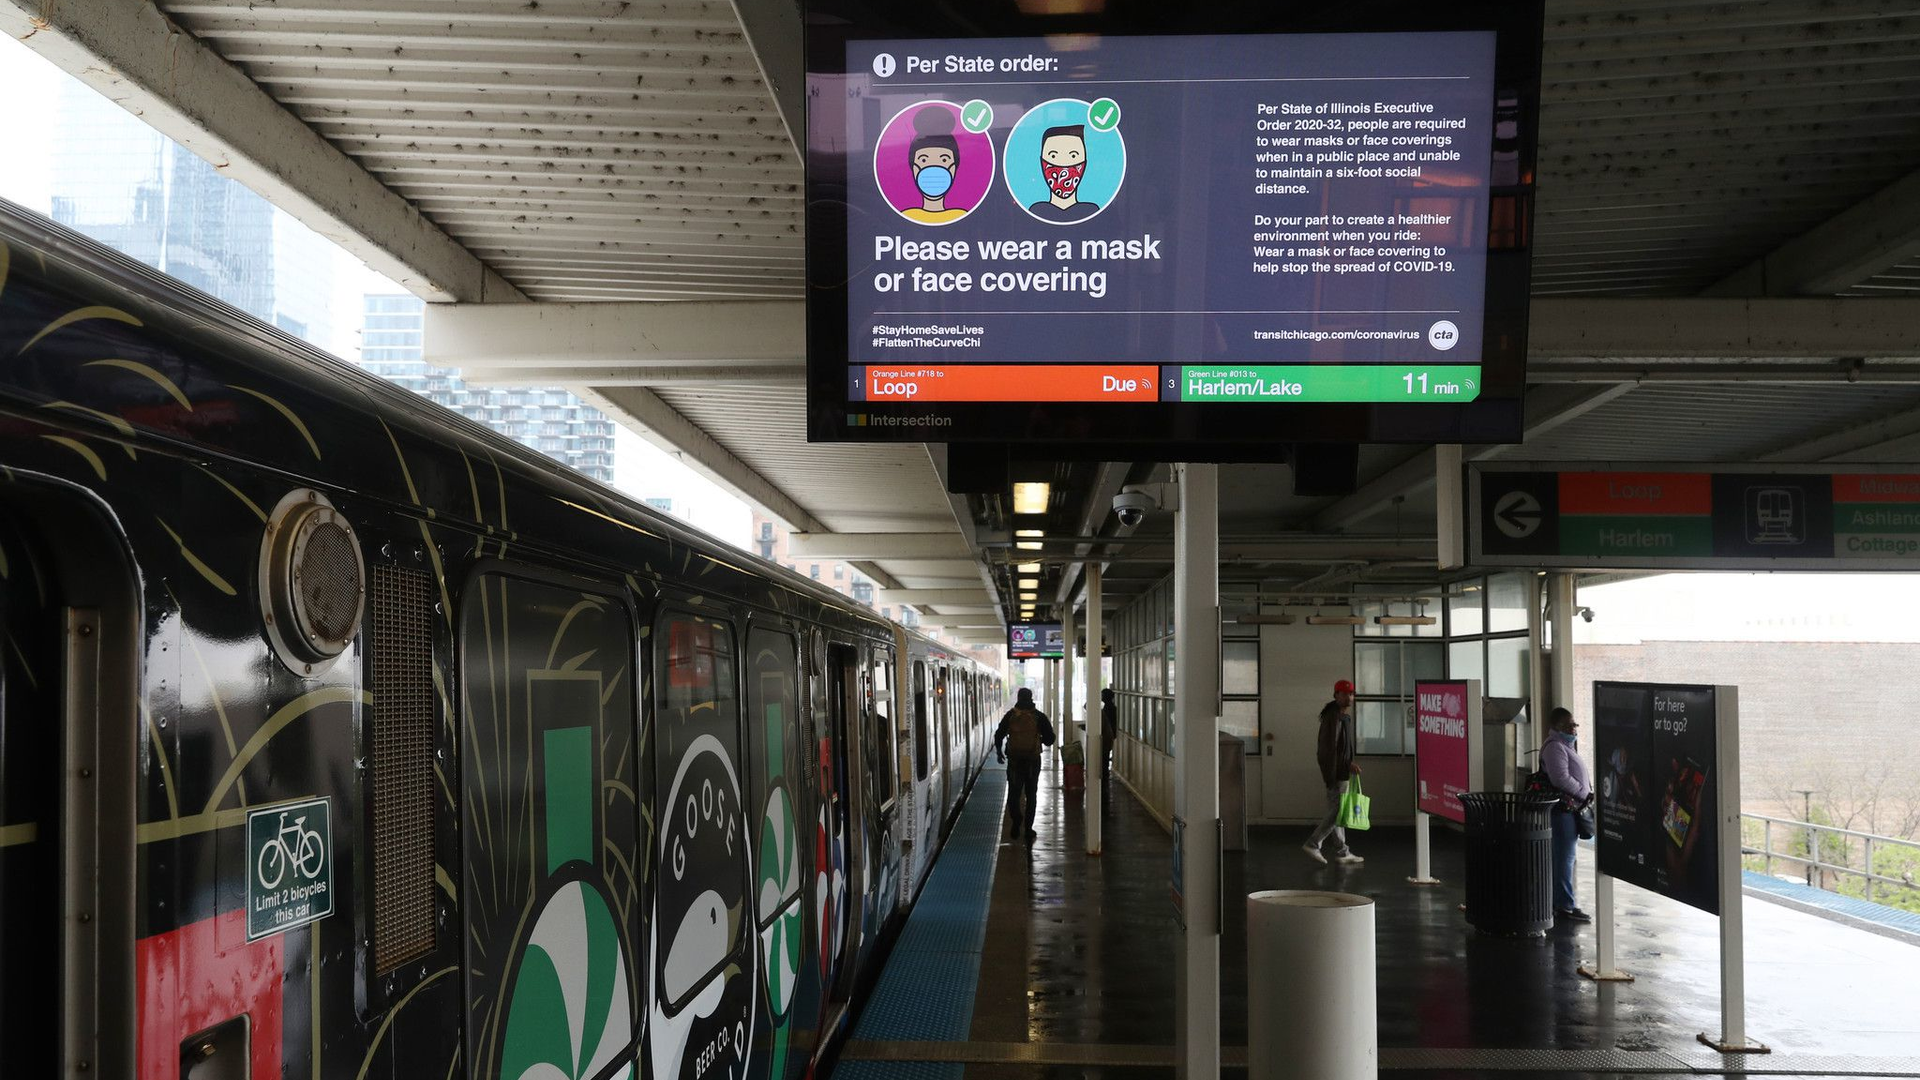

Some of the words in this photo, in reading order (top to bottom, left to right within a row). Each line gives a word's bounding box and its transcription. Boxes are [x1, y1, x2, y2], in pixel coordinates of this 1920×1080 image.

[907, 57, 939, 73] Per
[945, 55, 994, 72] State
[1000, 55, 1057, 71] order:
[1258, 104, 1278, 114] Per
[1282, 104, 1312, 114] State
[1316, 103, 1327, 113] of
[1331, 103, 1370, 113] Illinois
[1375, 102, 1433, 113] Executive
[1257, 120, 1291, 130] Order
[1295, 119, 1344, 131] 2020-32,
[1348, 119, 1389, 132] people
[1392, 121, 1411, 129] are
[1415, 118, 1465, 131] required
[1257, 136, 1268, 146] to
[1272, 138, 1301, 146] wear
[1304, 135, 1343, 145] masks
[1347, 137, 1360, 145] or
[1363, 135, 1388, 145] face
[1392, 134, 1451, 147] coverings
[1256, 152, 1288, 162] when
[1292, 152, 1302, 162] in
[1317, 151, 1354, 164] public
[1358, 151, 1389, 164] place
[1393, 151, 1415, 161] and
[1420, 150, 1460, 160] unable
[1256, 168, 1267, 178] to
[1271, 167, 1322, 178] maintain
[1337, 167, 1382, 177] six-foot
[1386, 166, 1420, 177] social
[1255, 184, 1309, 193] distance.
[1255, 215, 1271, 225] Do
[1275, 217, 1302, 227] your
[1305, 215, 1328, 227] part
[1332, 215, 1344, 224] to
[1347, 215, 1384, 224] create
[1399, 214, 1451, 224] healthier
[1254, 231, 1329, 241] environment
[1333, 230, 1364, 240] when
[1368, 233, 1390, 243] you
[1394, 230, 1420, 240] ride:
[876, 236, 969, 260] Please
[978, 241, 1047, 260] wear
[1056, 241, 1072, 259] a
[1082, 235, 1160, 259] mask
[1254, 247, 1284, 256] Wear
[1298, 246, 1330, 256] mask
[1334, 248, 1346, 256] or
[1349, 246, 1374, 256] face
[1378, 246, 1430, 258] covering
[1434, 246, 1445, 256] to
[1254, 262, 1278, 275] help
[1283, 263, 1308, 274] stop
[1312, 262, 1330, 272] the
[1334, 262, 1375, 274] spread
[1379, 262, 1390, 271] of
[1394, 261, 1454, 271] COVID-19.
[875, 273, 904, 292] or
[912, 267, 972, 291] face
[981, 267, 1106, 297] covering
[873, 325, 984, 336] #StayHomeSaveLives
[1254, 330, 1419, 341] transitchicago.com/coronavirus
[1434, 331, 1453, 339] cta
[873, 338, 980, 347] #FlattenTheCurveChi
[873, 370, 898, 378] Orange
[854, 379, 859, 388] 1
[874, 379, 917, 398] Loop
[1103, 376, 1136, 391] Due
[1169, 379, 1175, 388] 3
[1189, 379, 1302, 395] Harlem/Lake
[1403, 373, 1427, 393] 11
[1435, 382, 1458, 394] min
[871, 414, 951, 426] Intersection
[1610, 479, 1664, 505] Loop
[1860, 480, 1920, 493] Midwa
[1599, 530, 1673, 546] Harlem
[1847, 537, 1917, 554] Cottage
[1421, 694, 1441, 712] MAKE
[1655, 697, 1665, 711] For
[1667, 699, 1685, 712] here
[1420, 716, 1464, 738] SOMETHING
[1655, 719, 1662, 730] or
[1664, 720, 1671, 731] to
[1673, 719, 1687, 735] go?
[673, 778, 735, 881] GOOSE
[256, 893, 280, 911] Limit
[283, 890, 288, 903] 2
[291, 881, 326, 900] bicycles
[276, 907, 293, 924] this
[296, 903, 310, 917] car
[696, 1041, 715, 1080] BEER
[718, 1027, 730, 1052] CO.
